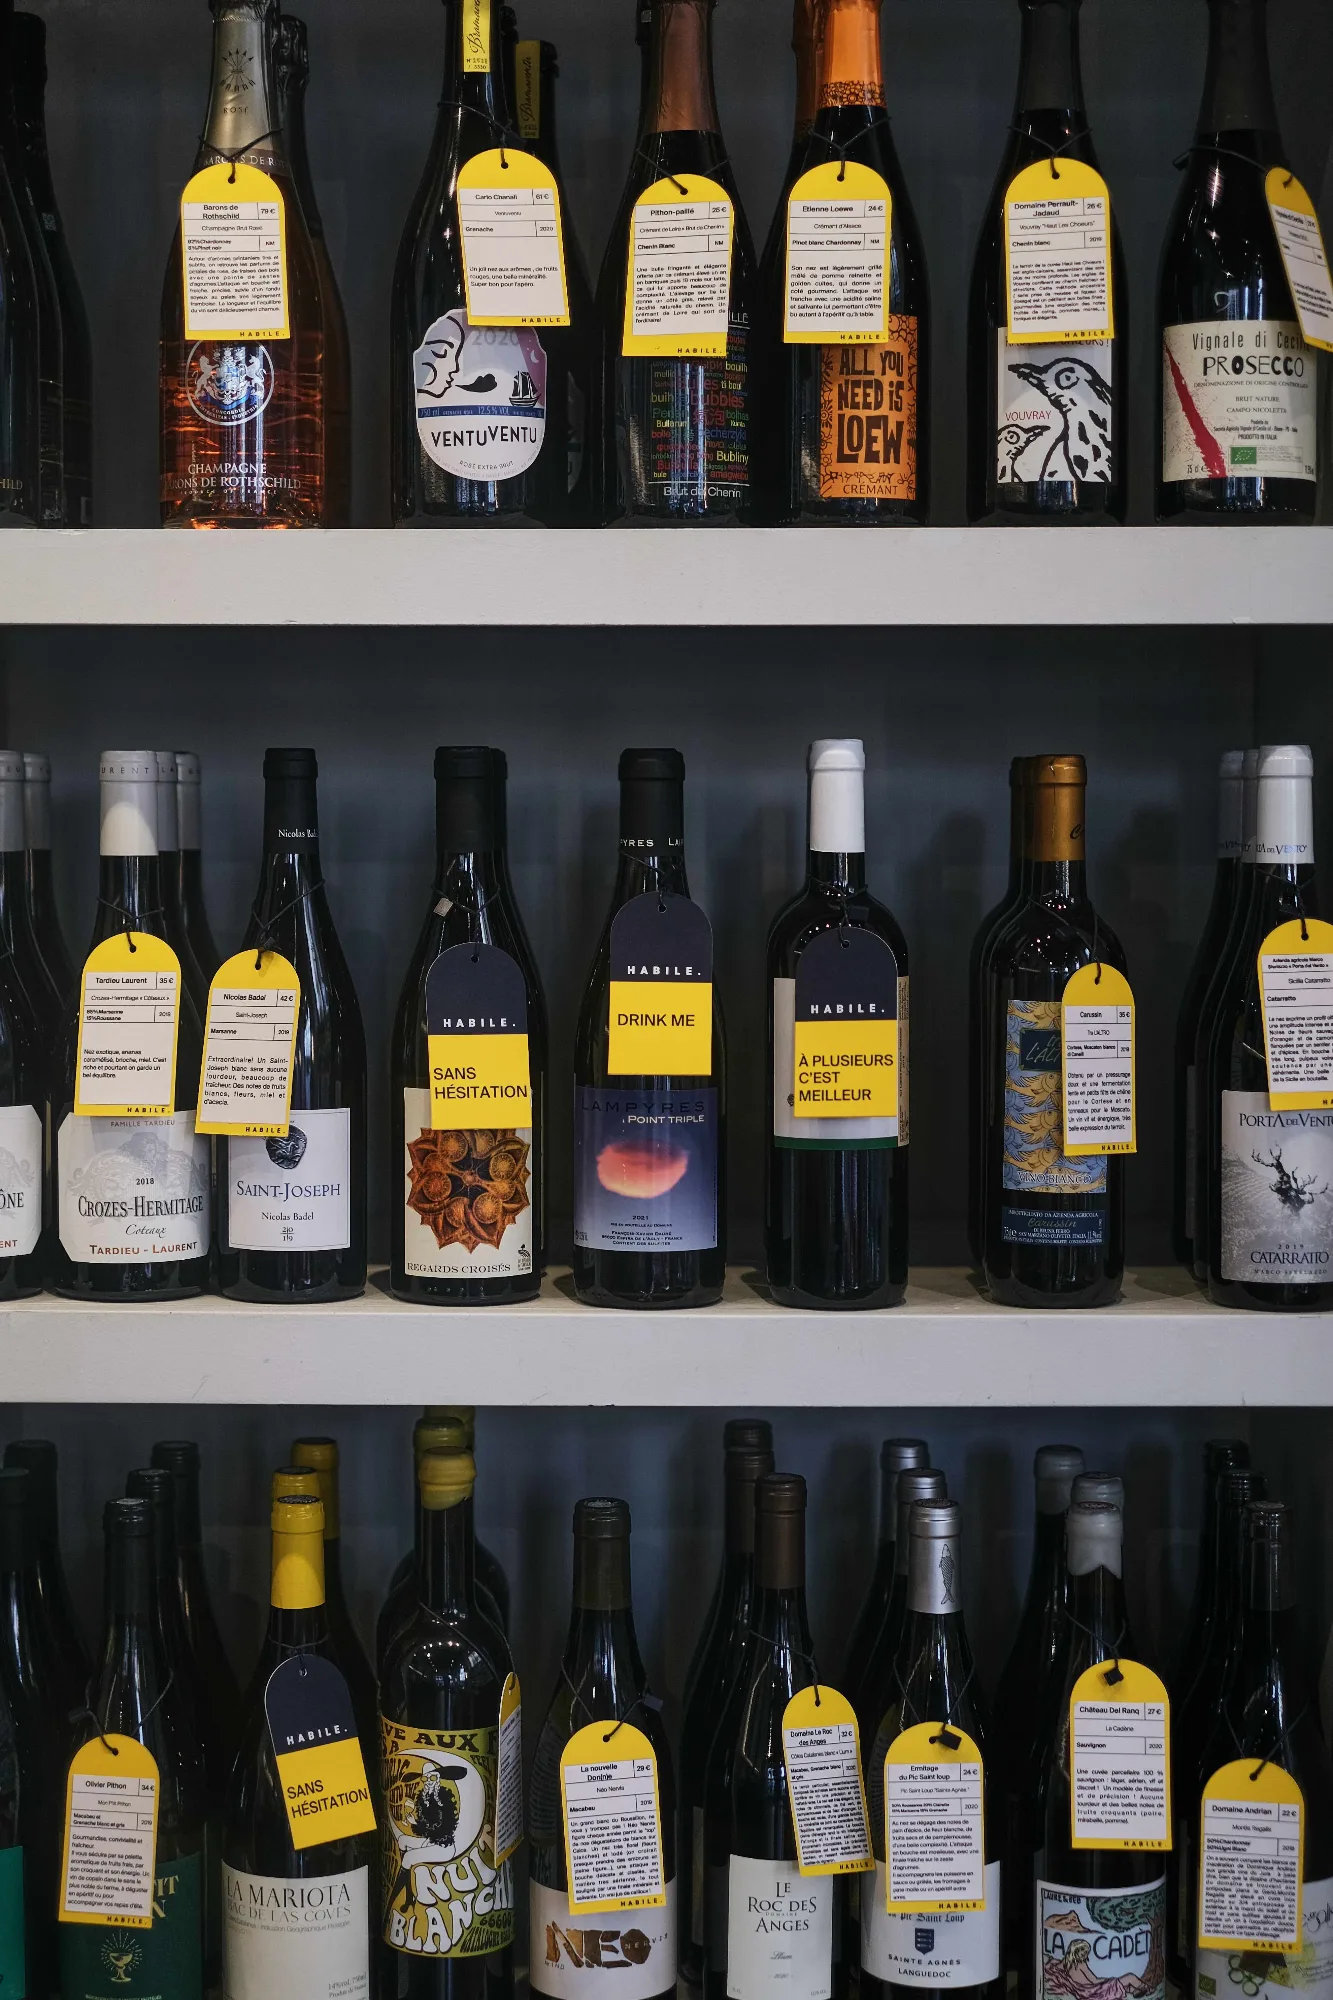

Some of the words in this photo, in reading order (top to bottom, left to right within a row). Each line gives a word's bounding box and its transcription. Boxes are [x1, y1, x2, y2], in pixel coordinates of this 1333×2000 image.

[1014, 202, 1046, 210] Domaine
[1033, 209, 1060, 217] Jadaud
[472, 329, 519, 346] 2020
[1192, 331, 1244, 351] Vignale
[1255, 331, 1267, 348] di
[839, 348, 875, 376] ALL
[879, 350, 904, 378] YOU
[1202, 355, 1305, 378] PROSECCO
[1193, 379, 1244, 388] DENOMINAZIONE
[837, 378, 884, 412] NEED
[1005, 410, 1052, 422] VOUVRAY
[431, 425, 537, 447] VENTUVENTU
[836, 413, 905, 465] LOEW
[188, 463, 267, 474] CHAMPAGNE
[201, 477, 217, 487] DE
[220, 476, 301, 489] ROTHSCHILD
[843, 481, 899, 495] CRÉMANT
[707, 486, 741, 498] Chenin
[278, 828, 305, 838] Nicolas
[627, 965, 702, 977] HABILE.
[223, 993, 247, 1001] Nicolas
[810, 1003, 885, 1014] HABILE.
[443, 1017, 517, 1028] HABILE.
[617, 1013, 668, 1028] DRINK
[670, 1013, 695, 1027] ME
[799, 1053, 809, 1067] À
[812, 1054, 894, 1067] PLUSIEURS
[206, 1073, 237, 1081] lourdeur,
[241, 1074, 275, 1082] beaucoup
[433, 1067, 477, 1081] SANS
[799, 1071, 841, 1084] C'EST
[233, 1091, 256, 1099] fleurs,
[434, 1084, 529, 1100] HÉSITATION
[799, 1089, 872, 1102] MEILLEUR
[581, 1097, 705, 1114] LAMPYRES
[110, 1120, 141, 1128] FAMILLE
[144, 1119, 176, 1127] TARDIEU
[627, 1115, 666, 1124] POINT
[668, 1114, 705, 1123] TRIPLE
[1239, 1113, 1286, 1128] PORTA
[1286, 1118, 1299, 1126] DEL
[245, 1126, 286, 1134] HABILE.
[135, 1177, 155, 1186] 2018
[1017, 1171, 1046, 1183] VINO
[1047, 1174, 1092, 1184] BIANCO
[236, 1180, 341, 1202] SAINT-JOSEPH
[78, 1194, 204, 1218] CROZES-HERMITAGE
[261, 1212, 291, 1221] Nicolas
[293, 1212, 314, 1221] Badel
[125, 1223, 167, 1238] Coteaux
[89, 1243, 140, 1256] TARDIEU
[152, 1241, 198, 1254] LAURENT
[1250, 1251, 1330, 1264] CATARRATTO
[407, 1262, 459, 1275] REGARDS
[461, 1261, 511, 1274] CROISÉS
[1079, 1706, 1108, 1714] Château
[1121, 1707, 1140, 1715] Ranq
[286, 1724, 348, 1746] HABILE.
[413, 1732, 480, 1753] AUX
[590, 1763, 618, 1772] nouvelle
[910, 1765, 939, 1773] Ermitage
[936, 1773, 950, 1781] loup
[85, 1780, 106, 1789] Olivier
[106, 1781, 127, 1790] Pithon
[287, 1779, 324, 1800] SANS
[291, 1788, 369, 1819] HÉSITATION
[569, 1805, 596, 1813] Macabeu
[1212, 1805, 1244, 1814] Domaine
[1244, 1807, 1272, 1816] Andrian
[1282, 1809, 1290, 1817] 22
[227, 1875, 243, 1902] LA
[249, 1883, 351, 1908] MARIOTA
[776, 1881, 791, 1898] LE
[748, 1896, 783, 1913] ROC
[789, 1896, 817, 1913] DES
[249, 1907, 267, 1921] DE
[271, 1909, 299, 1924] LAS
[304, 1904, 351, 1922] COVES
[755, 1917, 810, 1934] ANGES
[545, 1920, 652, 1969] NEO
[1043, 1929, 1065, 1956] LA
[888, 1953, 923, 1965] SAINTE
[898, 1967, 952, 1978] LANGUEDOC
